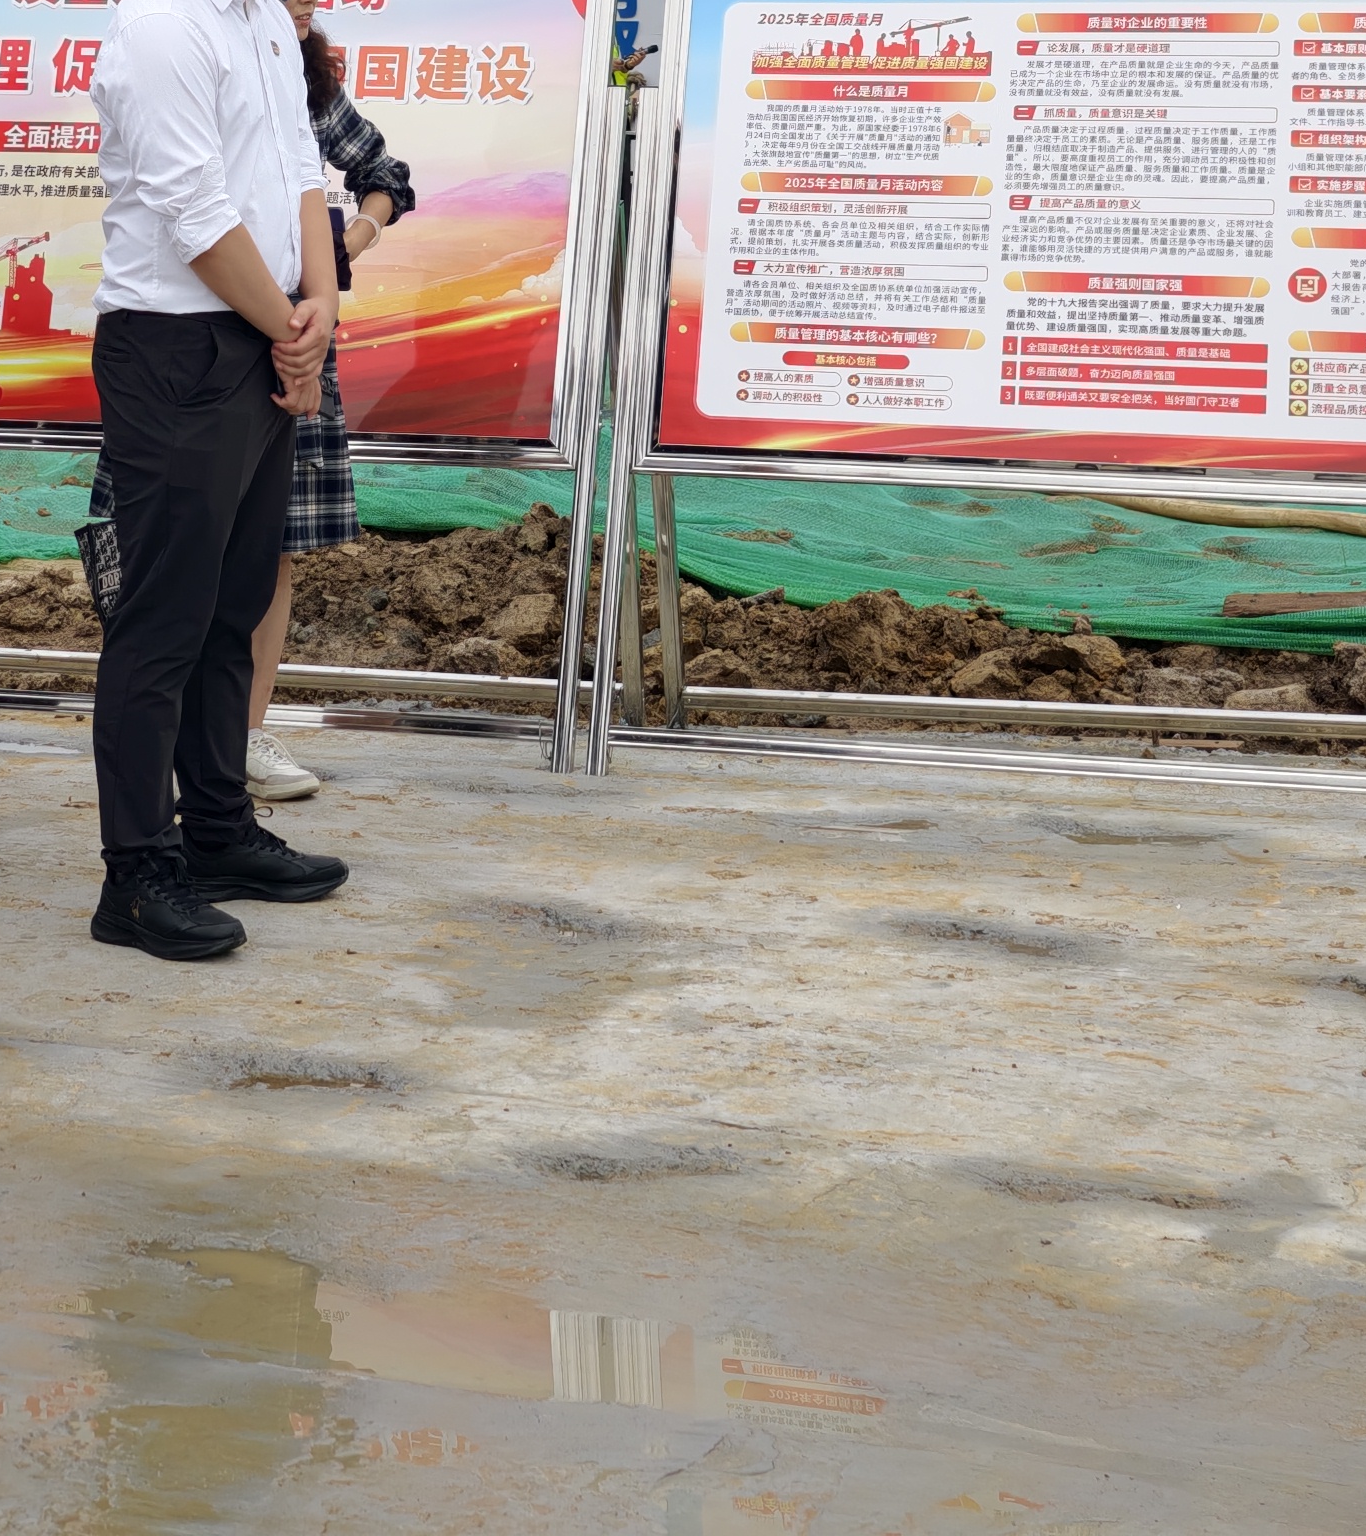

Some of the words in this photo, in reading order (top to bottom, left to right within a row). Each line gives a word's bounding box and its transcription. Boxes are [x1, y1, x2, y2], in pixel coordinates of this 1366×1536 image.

[758, 13, 883, 26] 2025年全国质量月
[1087, 16, 1207, 29] 质量对企业的重要性
[1047, 43, 1170, 54] 论发展，质量才是硬道理
[329, 45, 531, 100] 国建设
[833, 85, 908, 98] 什么是质量月
[1044, 108, 1167, 120] 抓质量，质量意识是关键
[1318, 134, 1366, 146] 组织架构
[785, 178, 943, 192] 2025年全国质量月活动内容
[1317, 180, 1365, 192] 实施步骤
[1039, 198, 1141, 210] 提高产品质量的意义
[1088, 278, 1183, 292] 质量强则国家强
[775, 327, 937, 344] 质量管理的基本核心有哪些?
[1007, 342, 1013, 351] 1
[816, 355, 876, 366] 基本核心包括
[1006, 367, 1012, 376] 2
[753, 372, 814, 384] 提高人的素质
[864, 376, 925, 388] 增强质量意识
[753, 391, 822, 403] 调动人的积极性
[863, 395, 944, 408] 人人做好本职工作
[1005, 391, 1011, 400] 3
